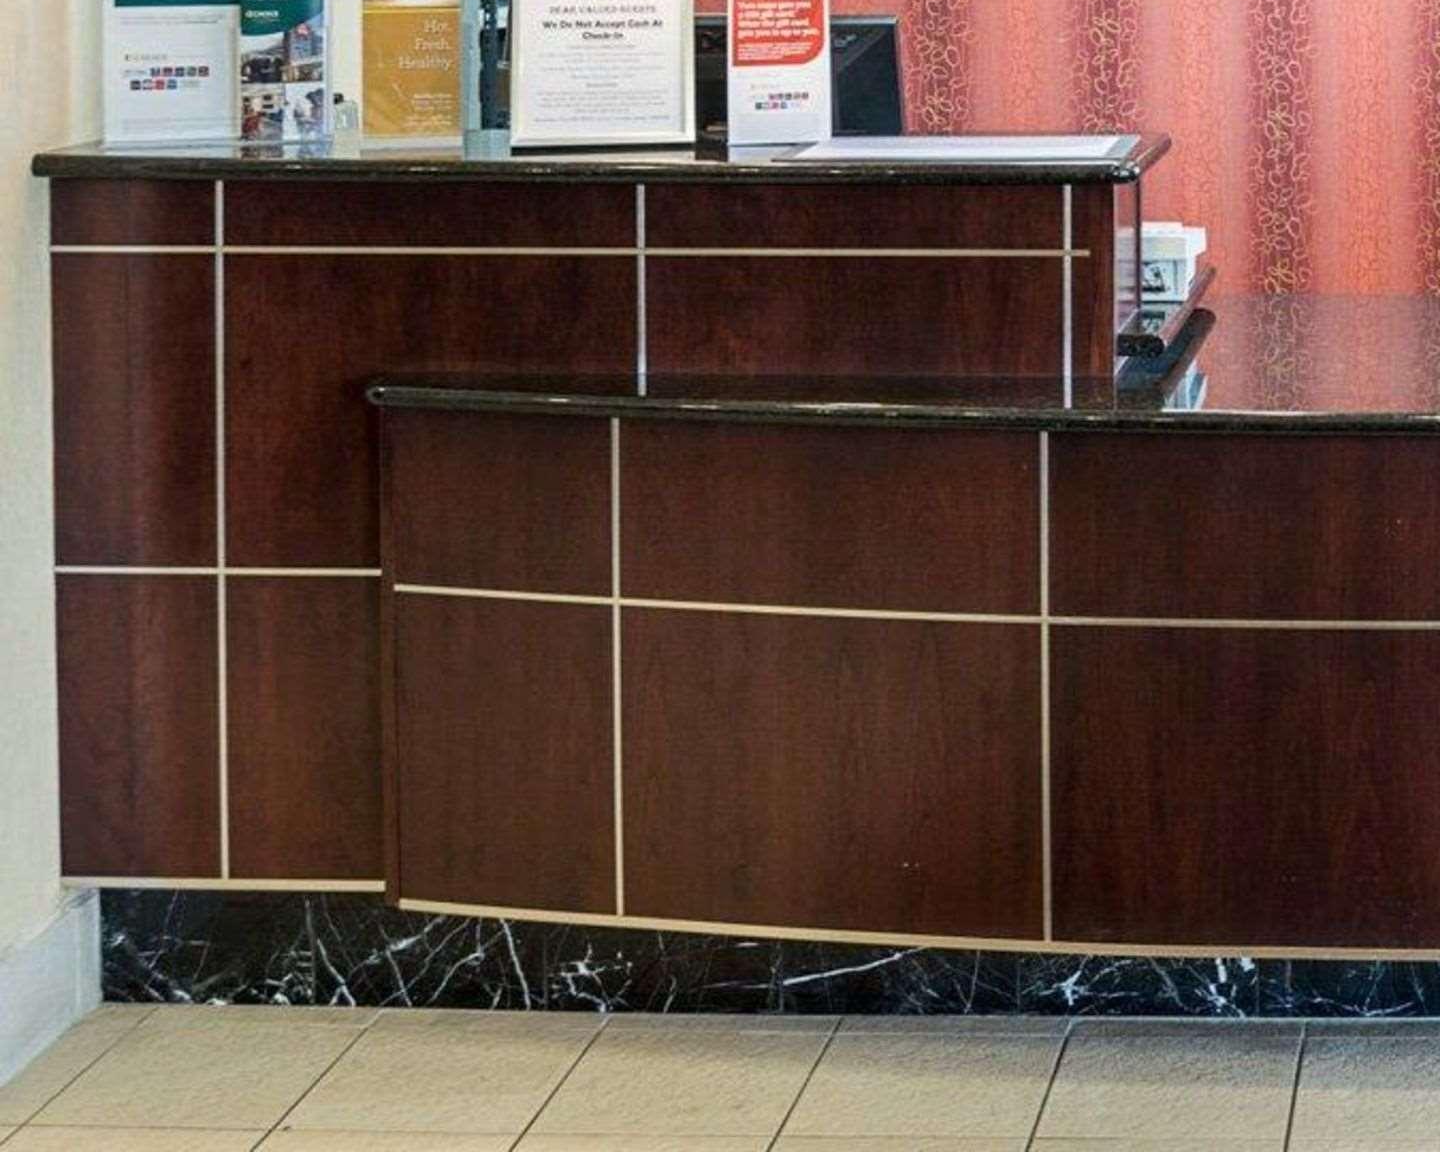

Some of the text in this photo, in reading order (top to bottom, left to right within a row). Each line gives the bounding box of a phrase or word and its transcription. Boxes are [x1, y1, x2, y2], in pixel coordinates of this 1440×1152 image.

[542, 20, 557, 29] We
[560, 20, 572, 29] Do
[575, 20, 592, 28] Not
[595, 19, 625, 29] Accept
[627, 18, 649, 28] Cash
